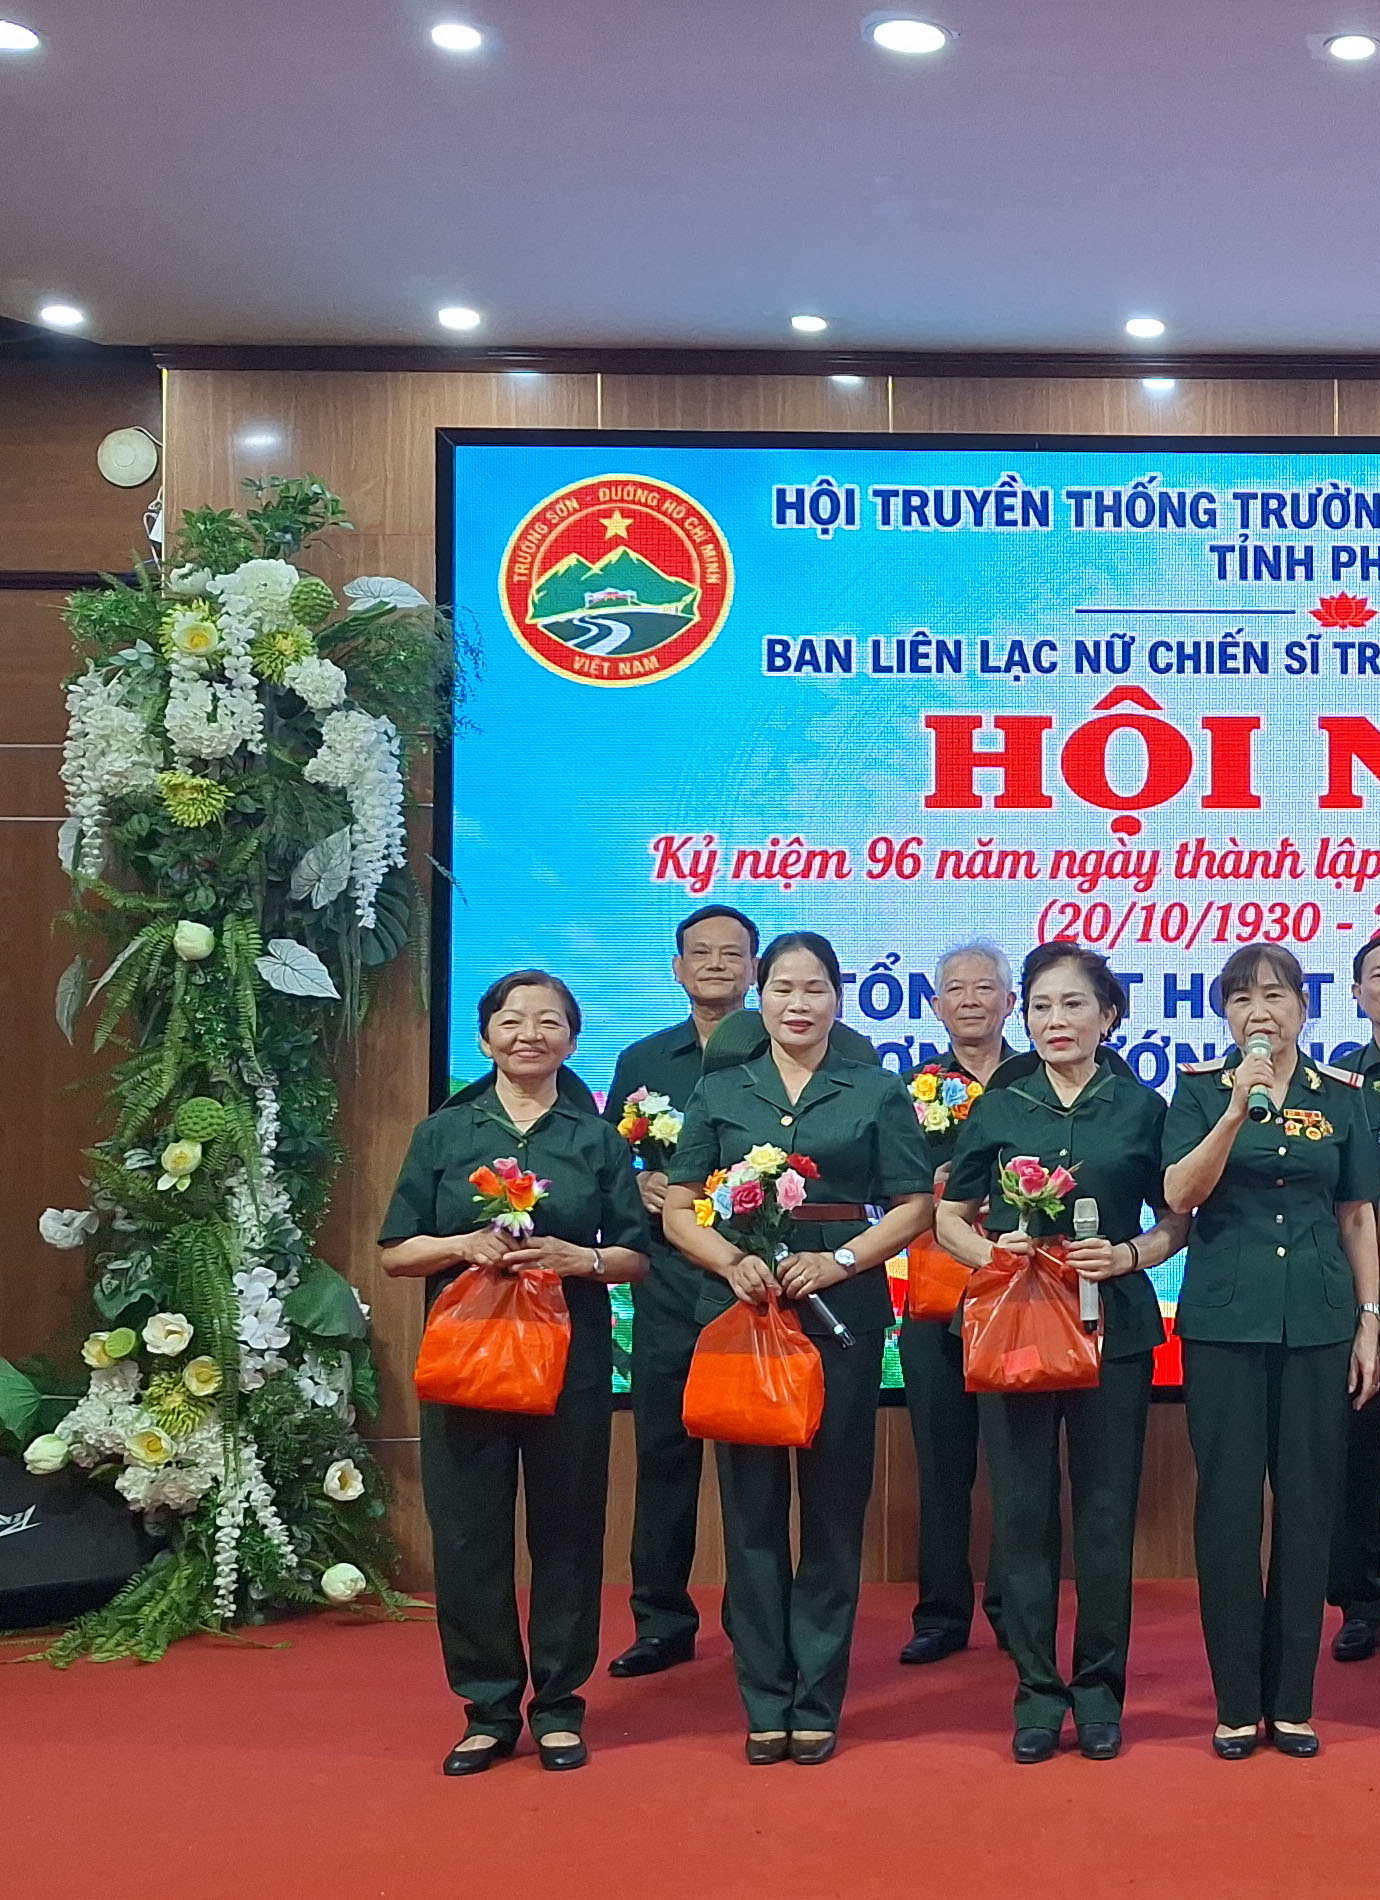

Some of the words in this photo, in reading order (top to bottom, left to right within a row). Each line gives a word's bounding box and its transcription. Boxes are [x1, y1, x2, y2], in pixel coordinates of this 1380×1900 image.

[775, 478, 856, 537] HỘI
[872, 473, 1050, 528] TRUYỀN
[1065, 474, 1217, 530] THỐNG
[702, 543, 721, 584] MINH
[1209, 534, 1314, 582] TỈNH
[619, 655, 660, 675] NAM
[766, 639, 852, 674] BAN
[872, 631, 962, 674] LIÊN
[980, 639, 1058, 683] LẠC
[1074, 632, 1137, 675] NỮ
[1148, 628, 1270, 675] CHIẾN
[1284, 633, 1322, 675] SĨ
[924, 685, 1262, 836] HỘI
[653, 836, 718, 892] Kỷ
[732, 838, 850, 891] niệm
[868, 837, 922, 879] 96
[936, 841, 1038, 879] năm
[1050, 846, 1160, 894] ngày
[1175, 838, 1302, 879] thành
[1037, 899, 1322, 950] (20/10/1930
